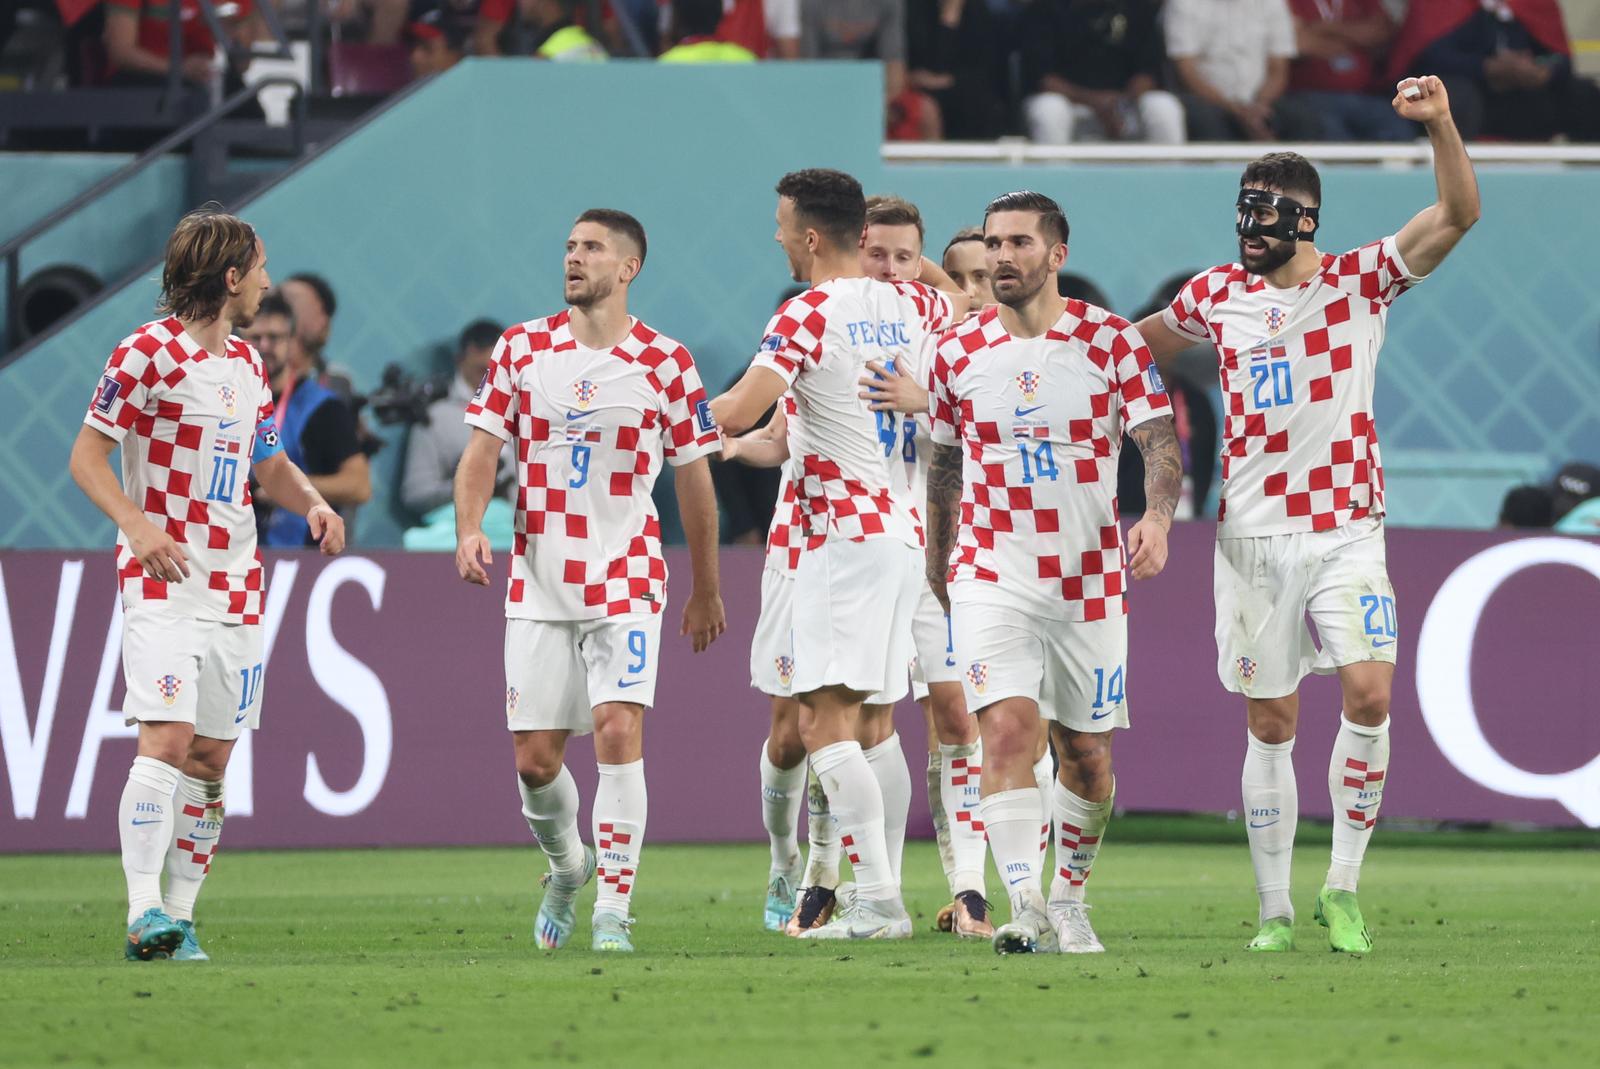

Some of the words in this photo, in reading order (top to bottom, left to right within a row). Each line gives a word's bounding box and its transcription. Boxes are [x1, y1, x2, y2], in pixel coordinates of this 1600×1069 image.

[1249, 361, 1294, 409] 20
[206, 455, 238, 503] 10
[569, 445, 591, 489] 9
[1016, 441, 1059, 484] 14
[1359, 594, 1397, 638] 20
[627, 630, 646, 674] 9
[238, 662, 263, 712] 10
[1092, 664, 1124, 709] 14
[135, 802, 164, 814] HNS
[1251, 807, 1280, 817] HNS
[604, 851, 630, 862] HNS
[1006, 862, 1030, 874] HNS
